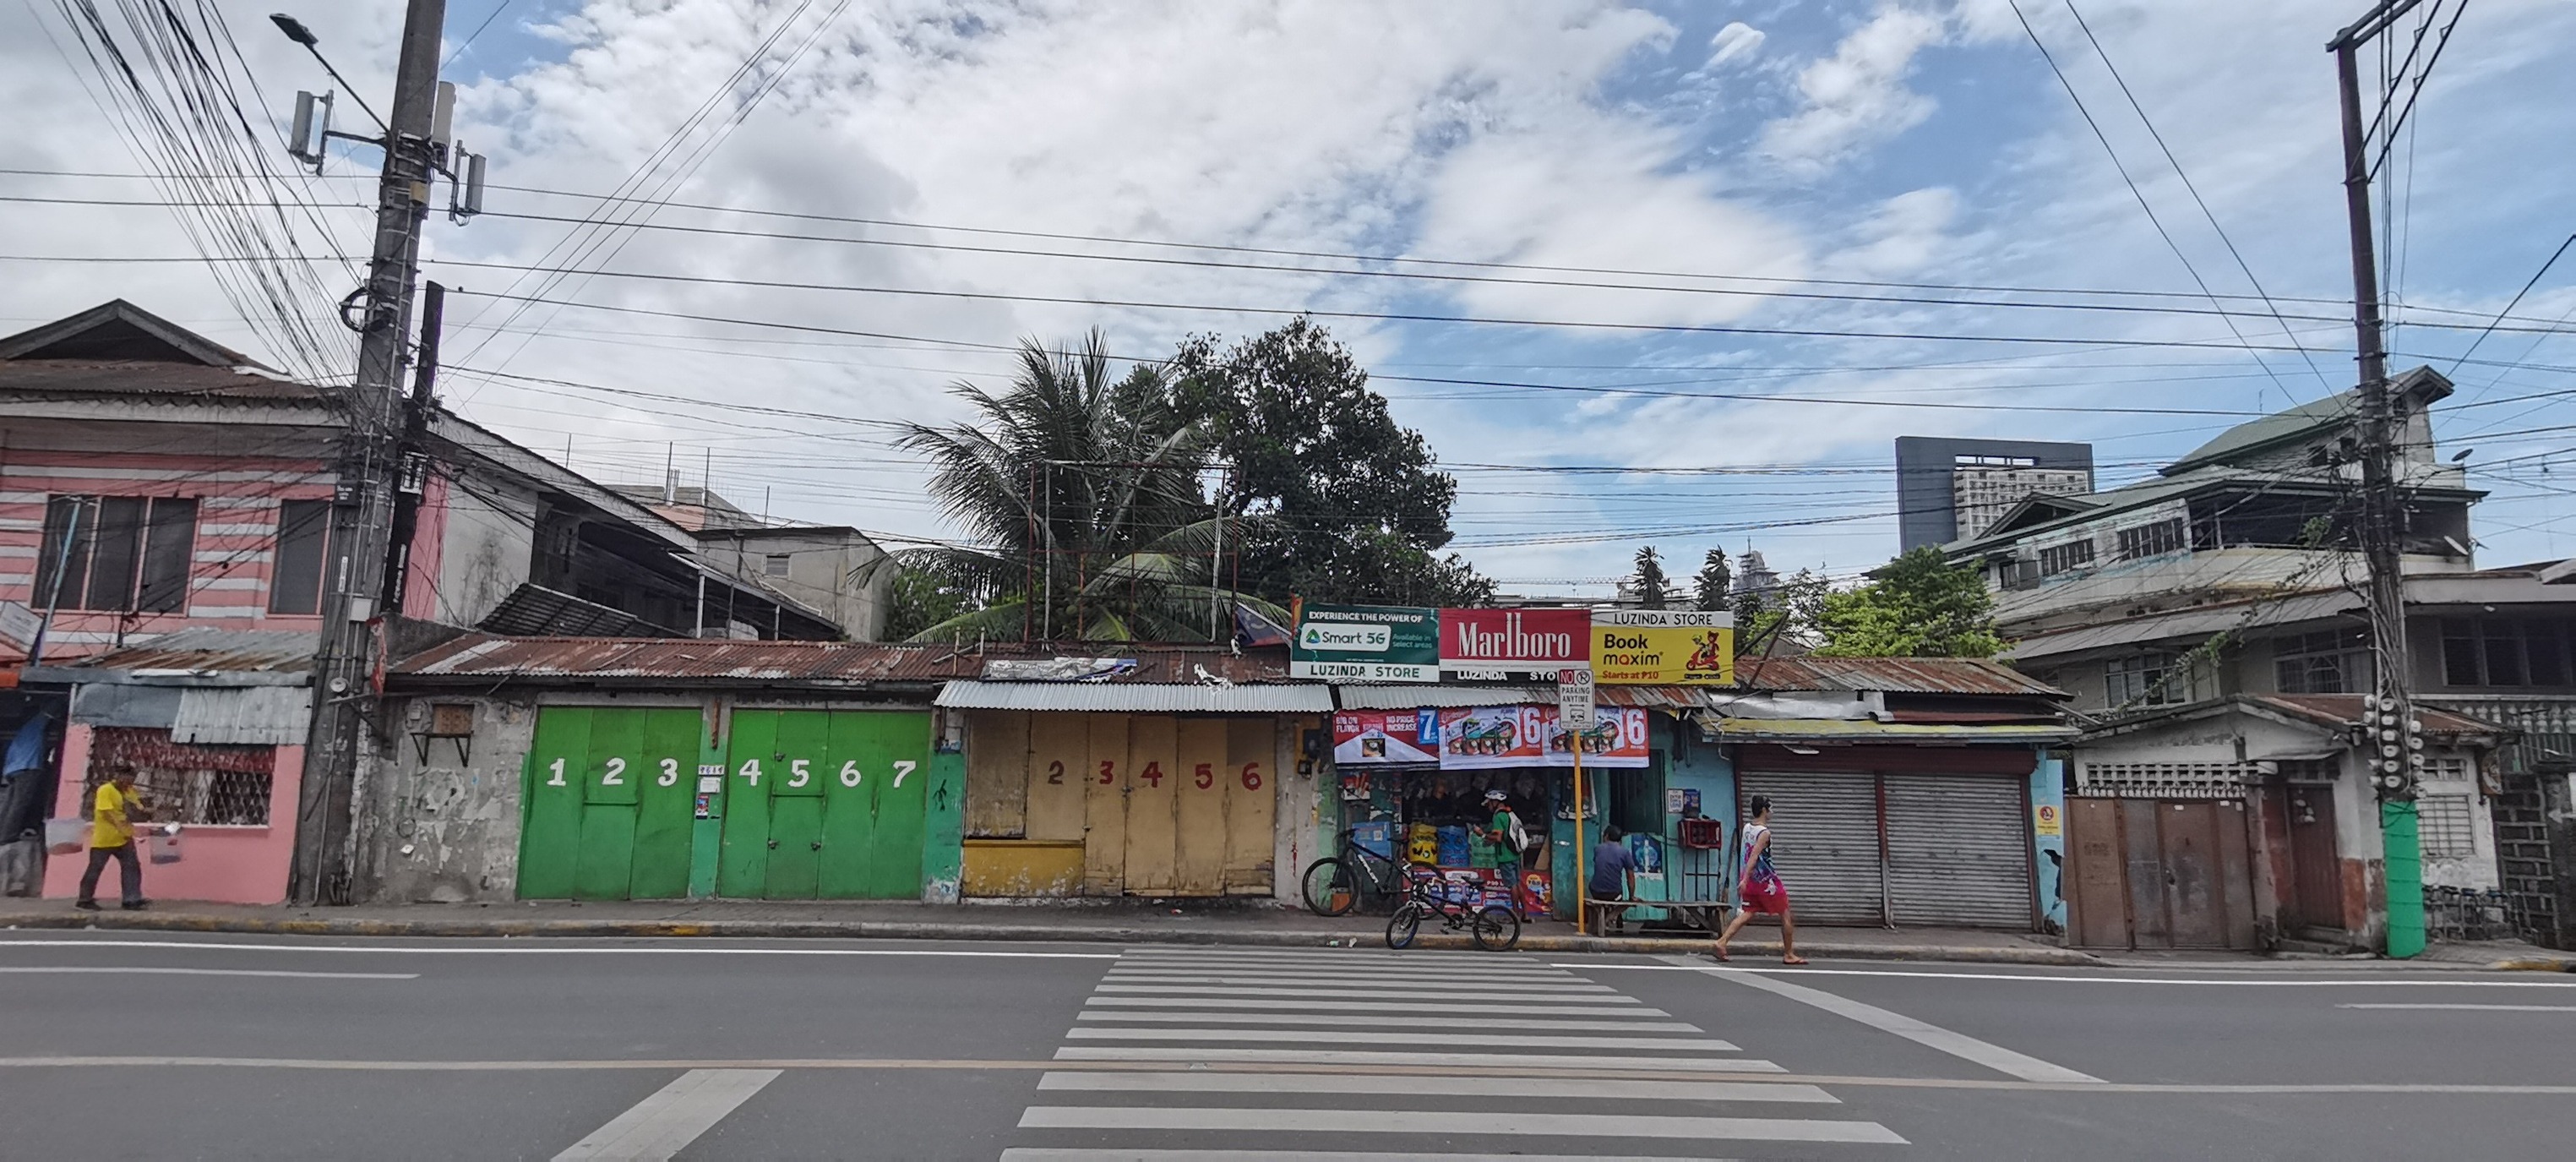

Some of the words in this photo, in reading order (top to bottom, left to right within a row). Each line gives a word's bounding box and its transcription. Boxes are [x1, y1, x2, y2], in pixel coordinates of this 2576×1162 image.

[1309, 611, 1360, 621] EXPERIENCE
[1361, 613, 1377, 622] THE
[1379, 614, 1408, 623] POWER
[1409, 614, 1424, 624] OF
[1615, 614, 1668, 625] LUZINDA
[1674, 614, 1713, 625] STORE
[1321, 631, 1362, 644] Smart
[1365, 632, 1386, 645] 5G
[1457, 611, 1571, 658] Marlboro
[1604, 633, 1648, 649] Book
[1604, 651, 1660, 666] maxim
[1310, 664, 1366, 677] LUZINDA
[1375, 666, 1420, 679] STORE
[1457, 669, 1508, 681] LUZINDA
[1529, 671, 1559, 681] STO
[1560, 670, 1575, 685] NO
[1603, 670, 1629, 679] Starts
[1630, 671, 1639, 679] at
[1561, 686, 1590, 695] PARKING
[1562, 695, 1588, 703] ANYTIME
[1396, 715, 1415, 723] PRICE
[1419, 709, 1435, 740] 7
[546, 757, 567, 787] 1
[602, 757, 626, 786] 2
[657, 758, 678, 787] 3
[738, 759, 762, 787] 4
[787, 759, 809, 788] 5
[840, 760, 862, 788] 6
[892, 761, 917, 788] 7
[1047, 760, 1065, 785] 2
[1099, 761, 1114, 785] 3
[1141, 761, 1163, 788] 4
[1195, 763, 1213, 789] 5
[1241, 762, 1262, 791] 6
